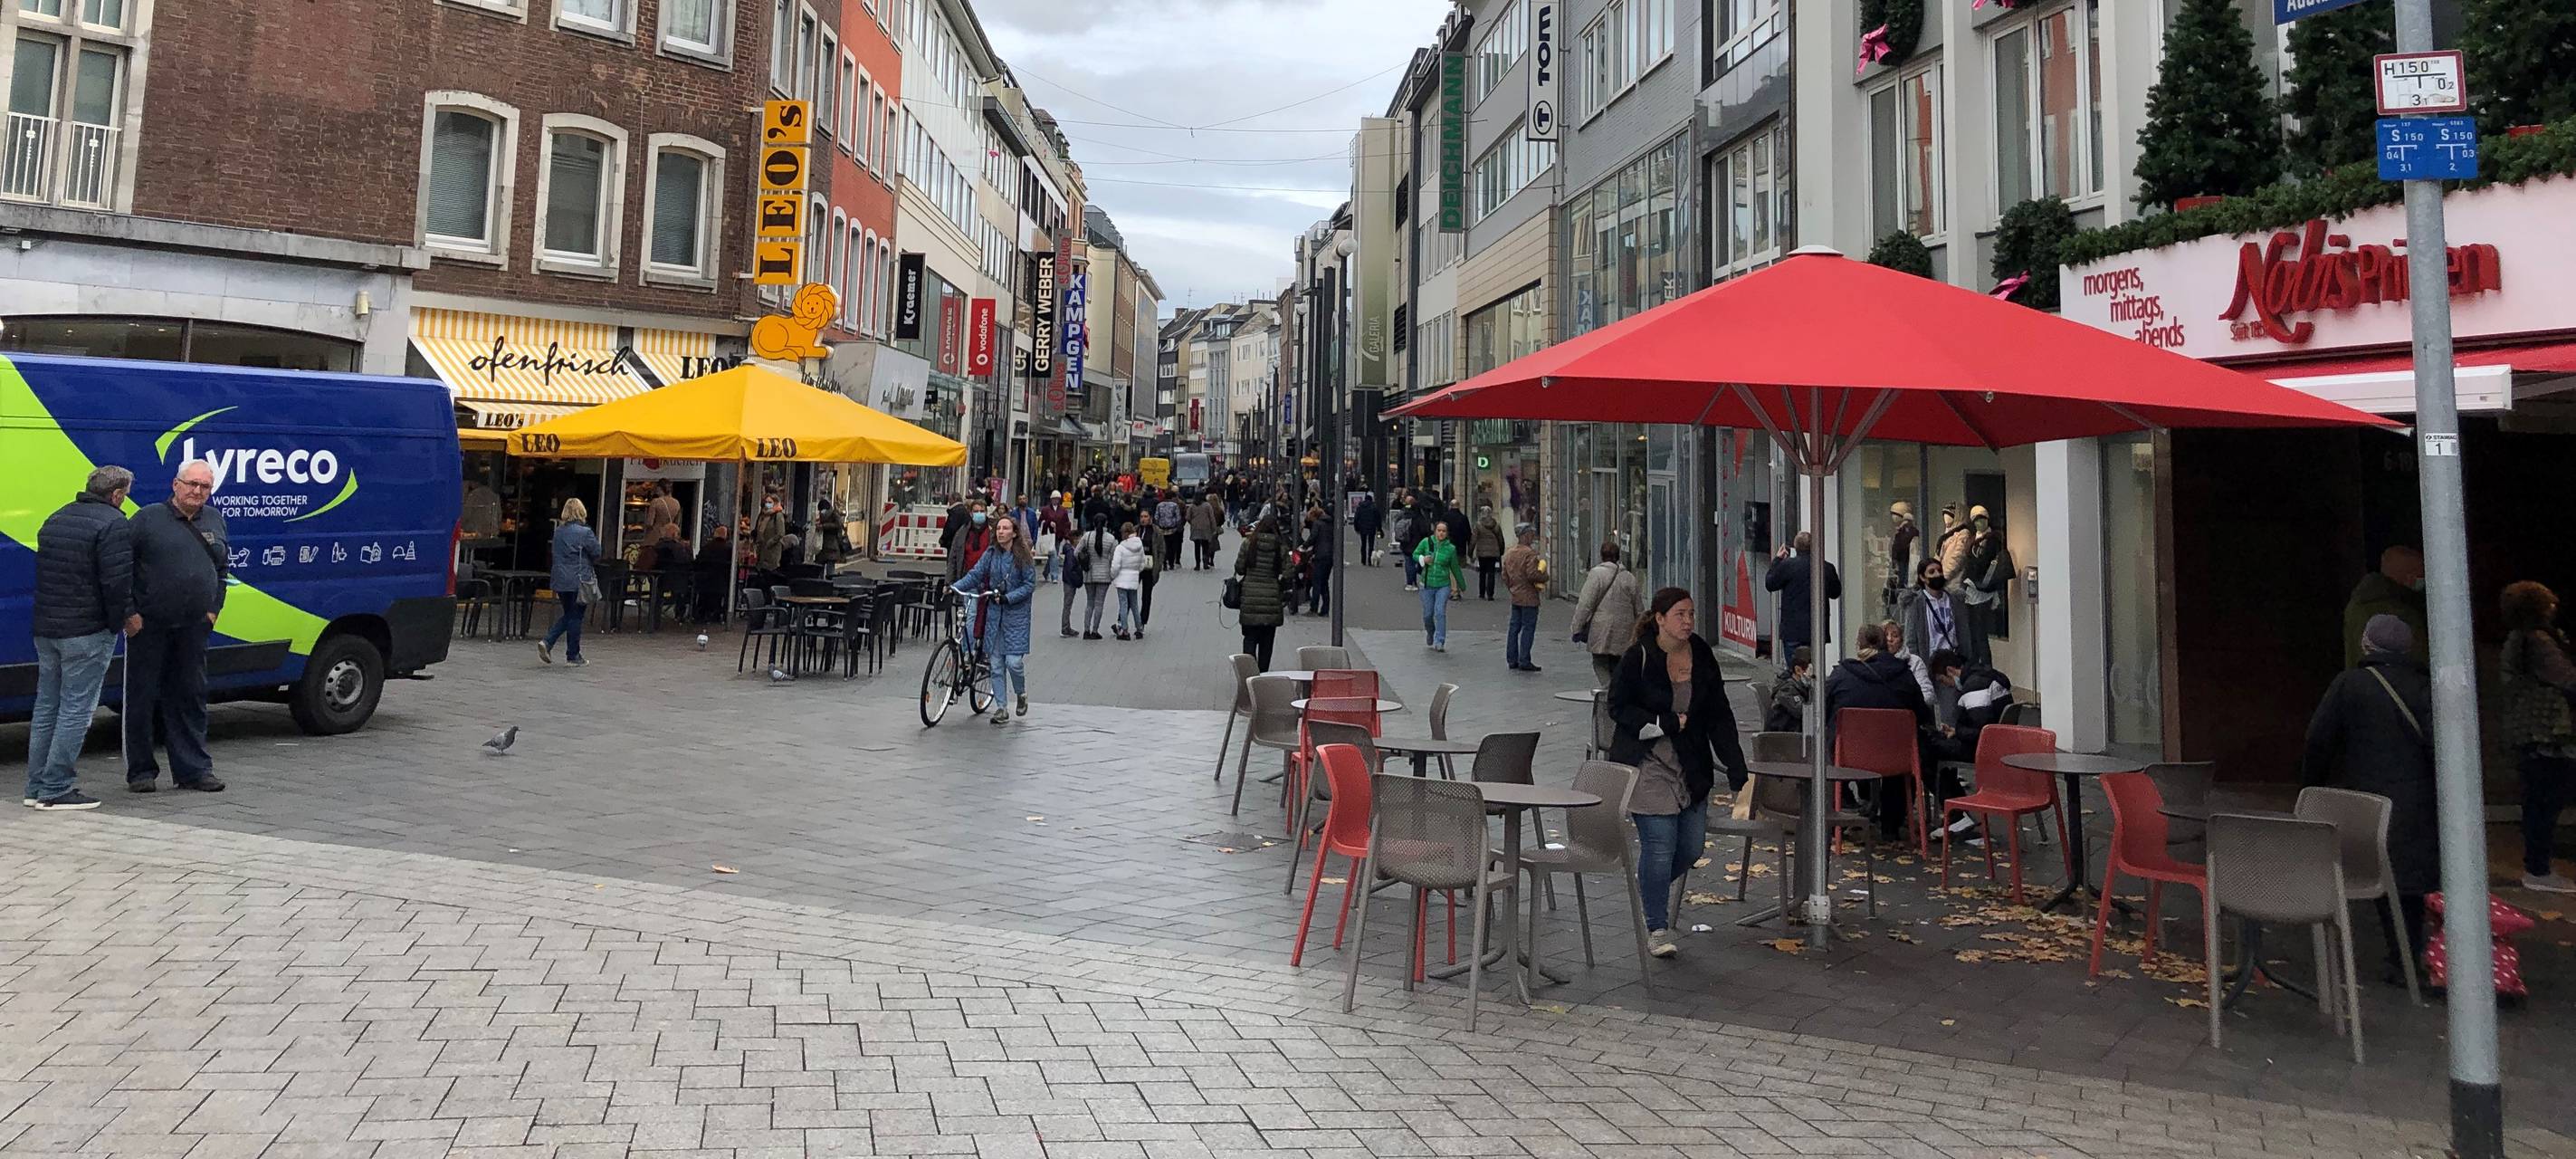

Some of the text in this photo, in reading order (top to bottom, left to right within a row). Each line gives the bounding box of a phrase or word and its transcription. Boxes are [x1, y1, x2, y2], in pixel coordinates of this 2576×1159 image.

[1442, 55, 1463, 228] DEICHMANN
[903, 269, 917, 325] Kraemer
[2084, 267, 2143, 300] morgens,
[1035, 257, 1054, 371] GERRY WEBER
[2110, 292, 2164, 326] mittags,
[978, 308, 988, 351] vodafone
[1065, 274, 1083, 388] KAMPGEN
[1369, 317, 1380, 353] GALERIA
[2134, 316, 2185, 348] abends
[468, 336, 629, 386] ofenfrisch
[521, 434, 561, 453] LEO
[756, 437, 797, 458] LEO
[2435, 443, 2441, 455] 1
[1477, 456, 1489, 468] D
[213, 495, 308, 506] WORKING TOGETHER
[221, 506, 299, 517] FOR TOMORROW
